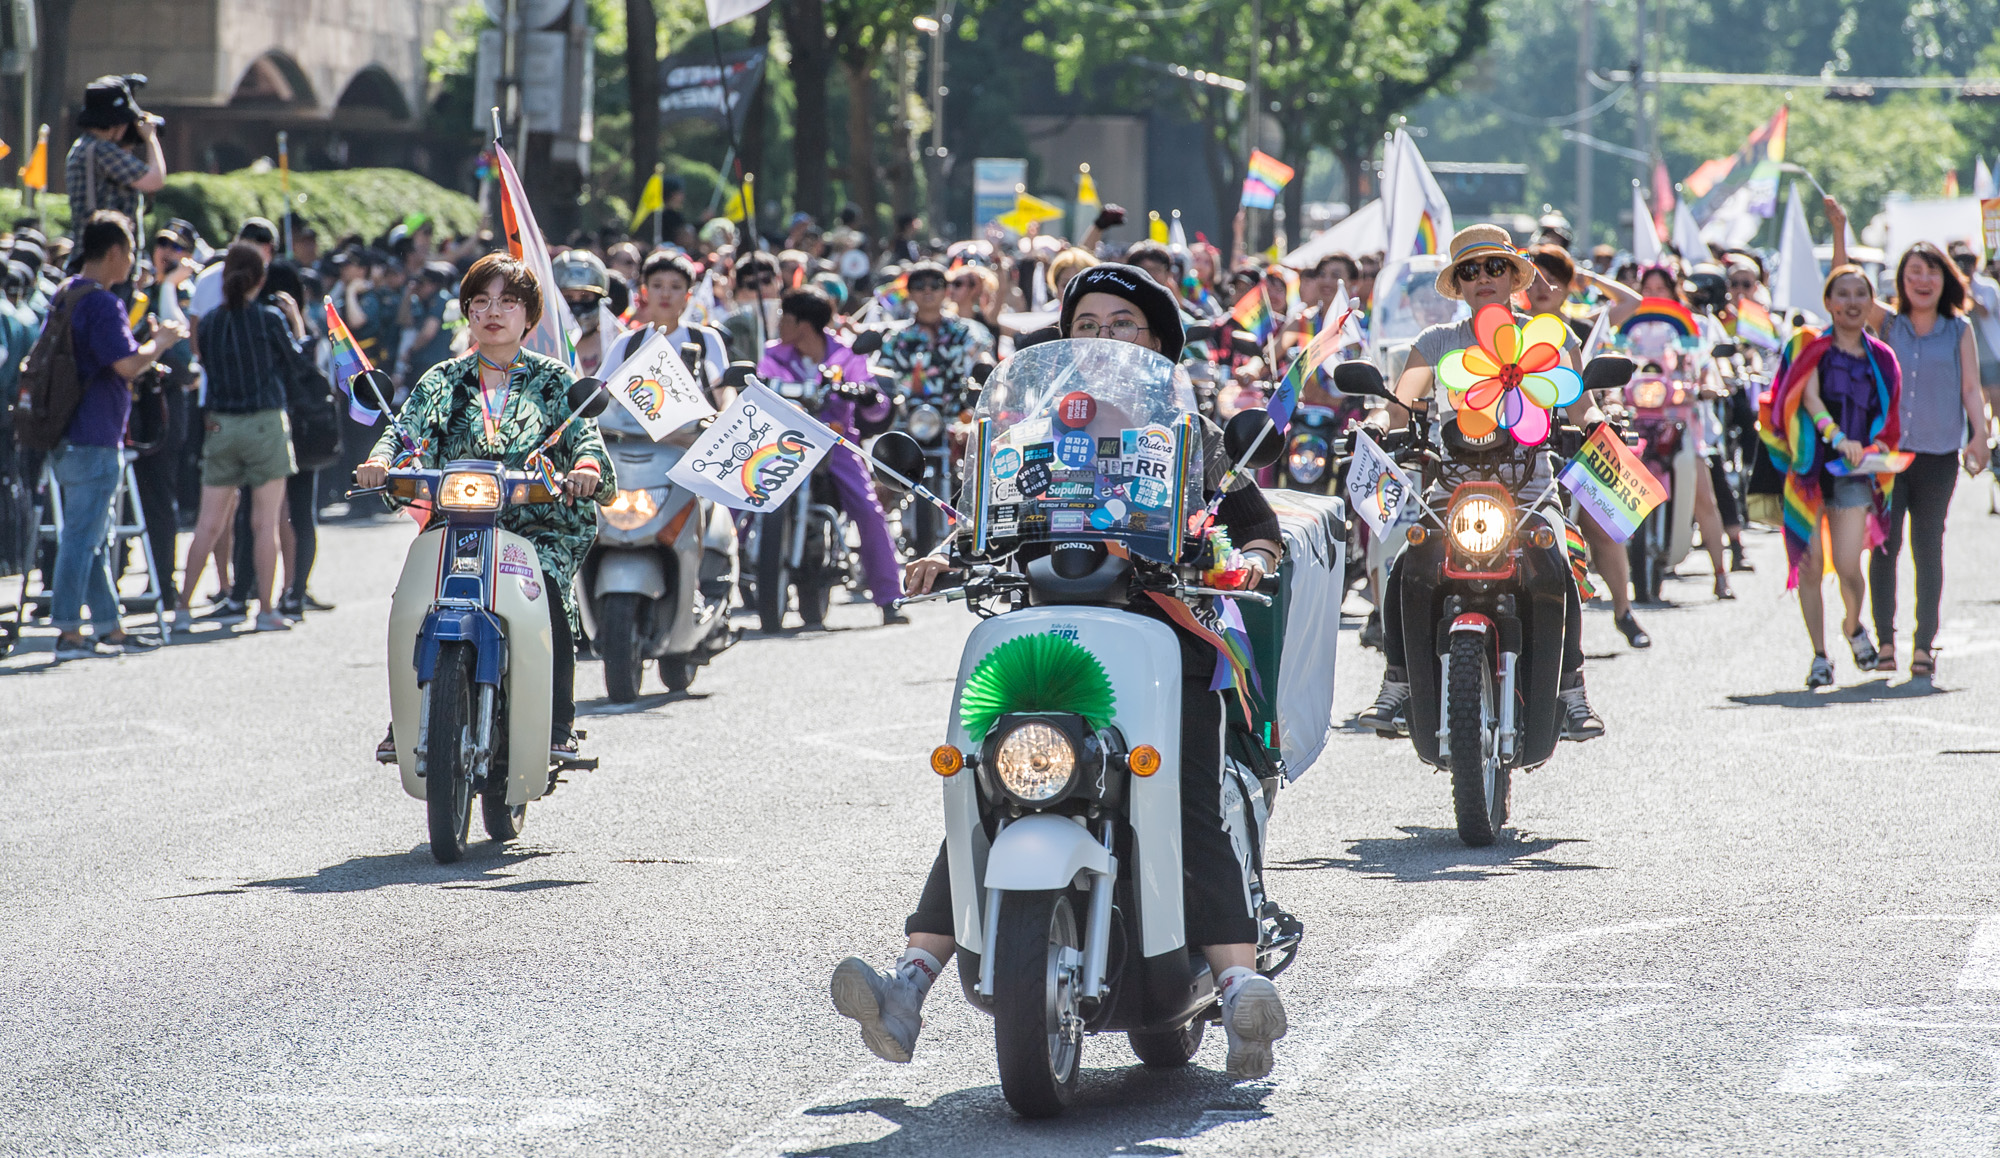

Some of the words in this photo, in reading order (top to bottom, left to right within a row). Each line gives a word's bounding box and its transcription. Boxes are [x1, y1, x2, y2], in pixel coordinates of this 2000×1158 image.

[1087, 270, 1104, 283] Holy
[1104, 271, 1137, 291] Feminist
[623, 375, 661, 421] Riders
[1063, 444, 1088, 454] 큰일을
[1065, 436, 1090, 446] 여자가
[1138, 435, 1173, 454] Riders
[1136, 459, 1167, 480] RR
[1596, 441, 1650, 497] RAINBOW
[1586, 449, 1641, 512] RIDERS
[1047, 483, 1093, 498] Supullim
[1581, 480, 1598, 499] with
[1591, 497, 1615, 520] pride
[458, 530, 478, 547] Citi
[1054, 542, 1096, 552] HONDA
[500, 564, 532, 576] FEMINIST
